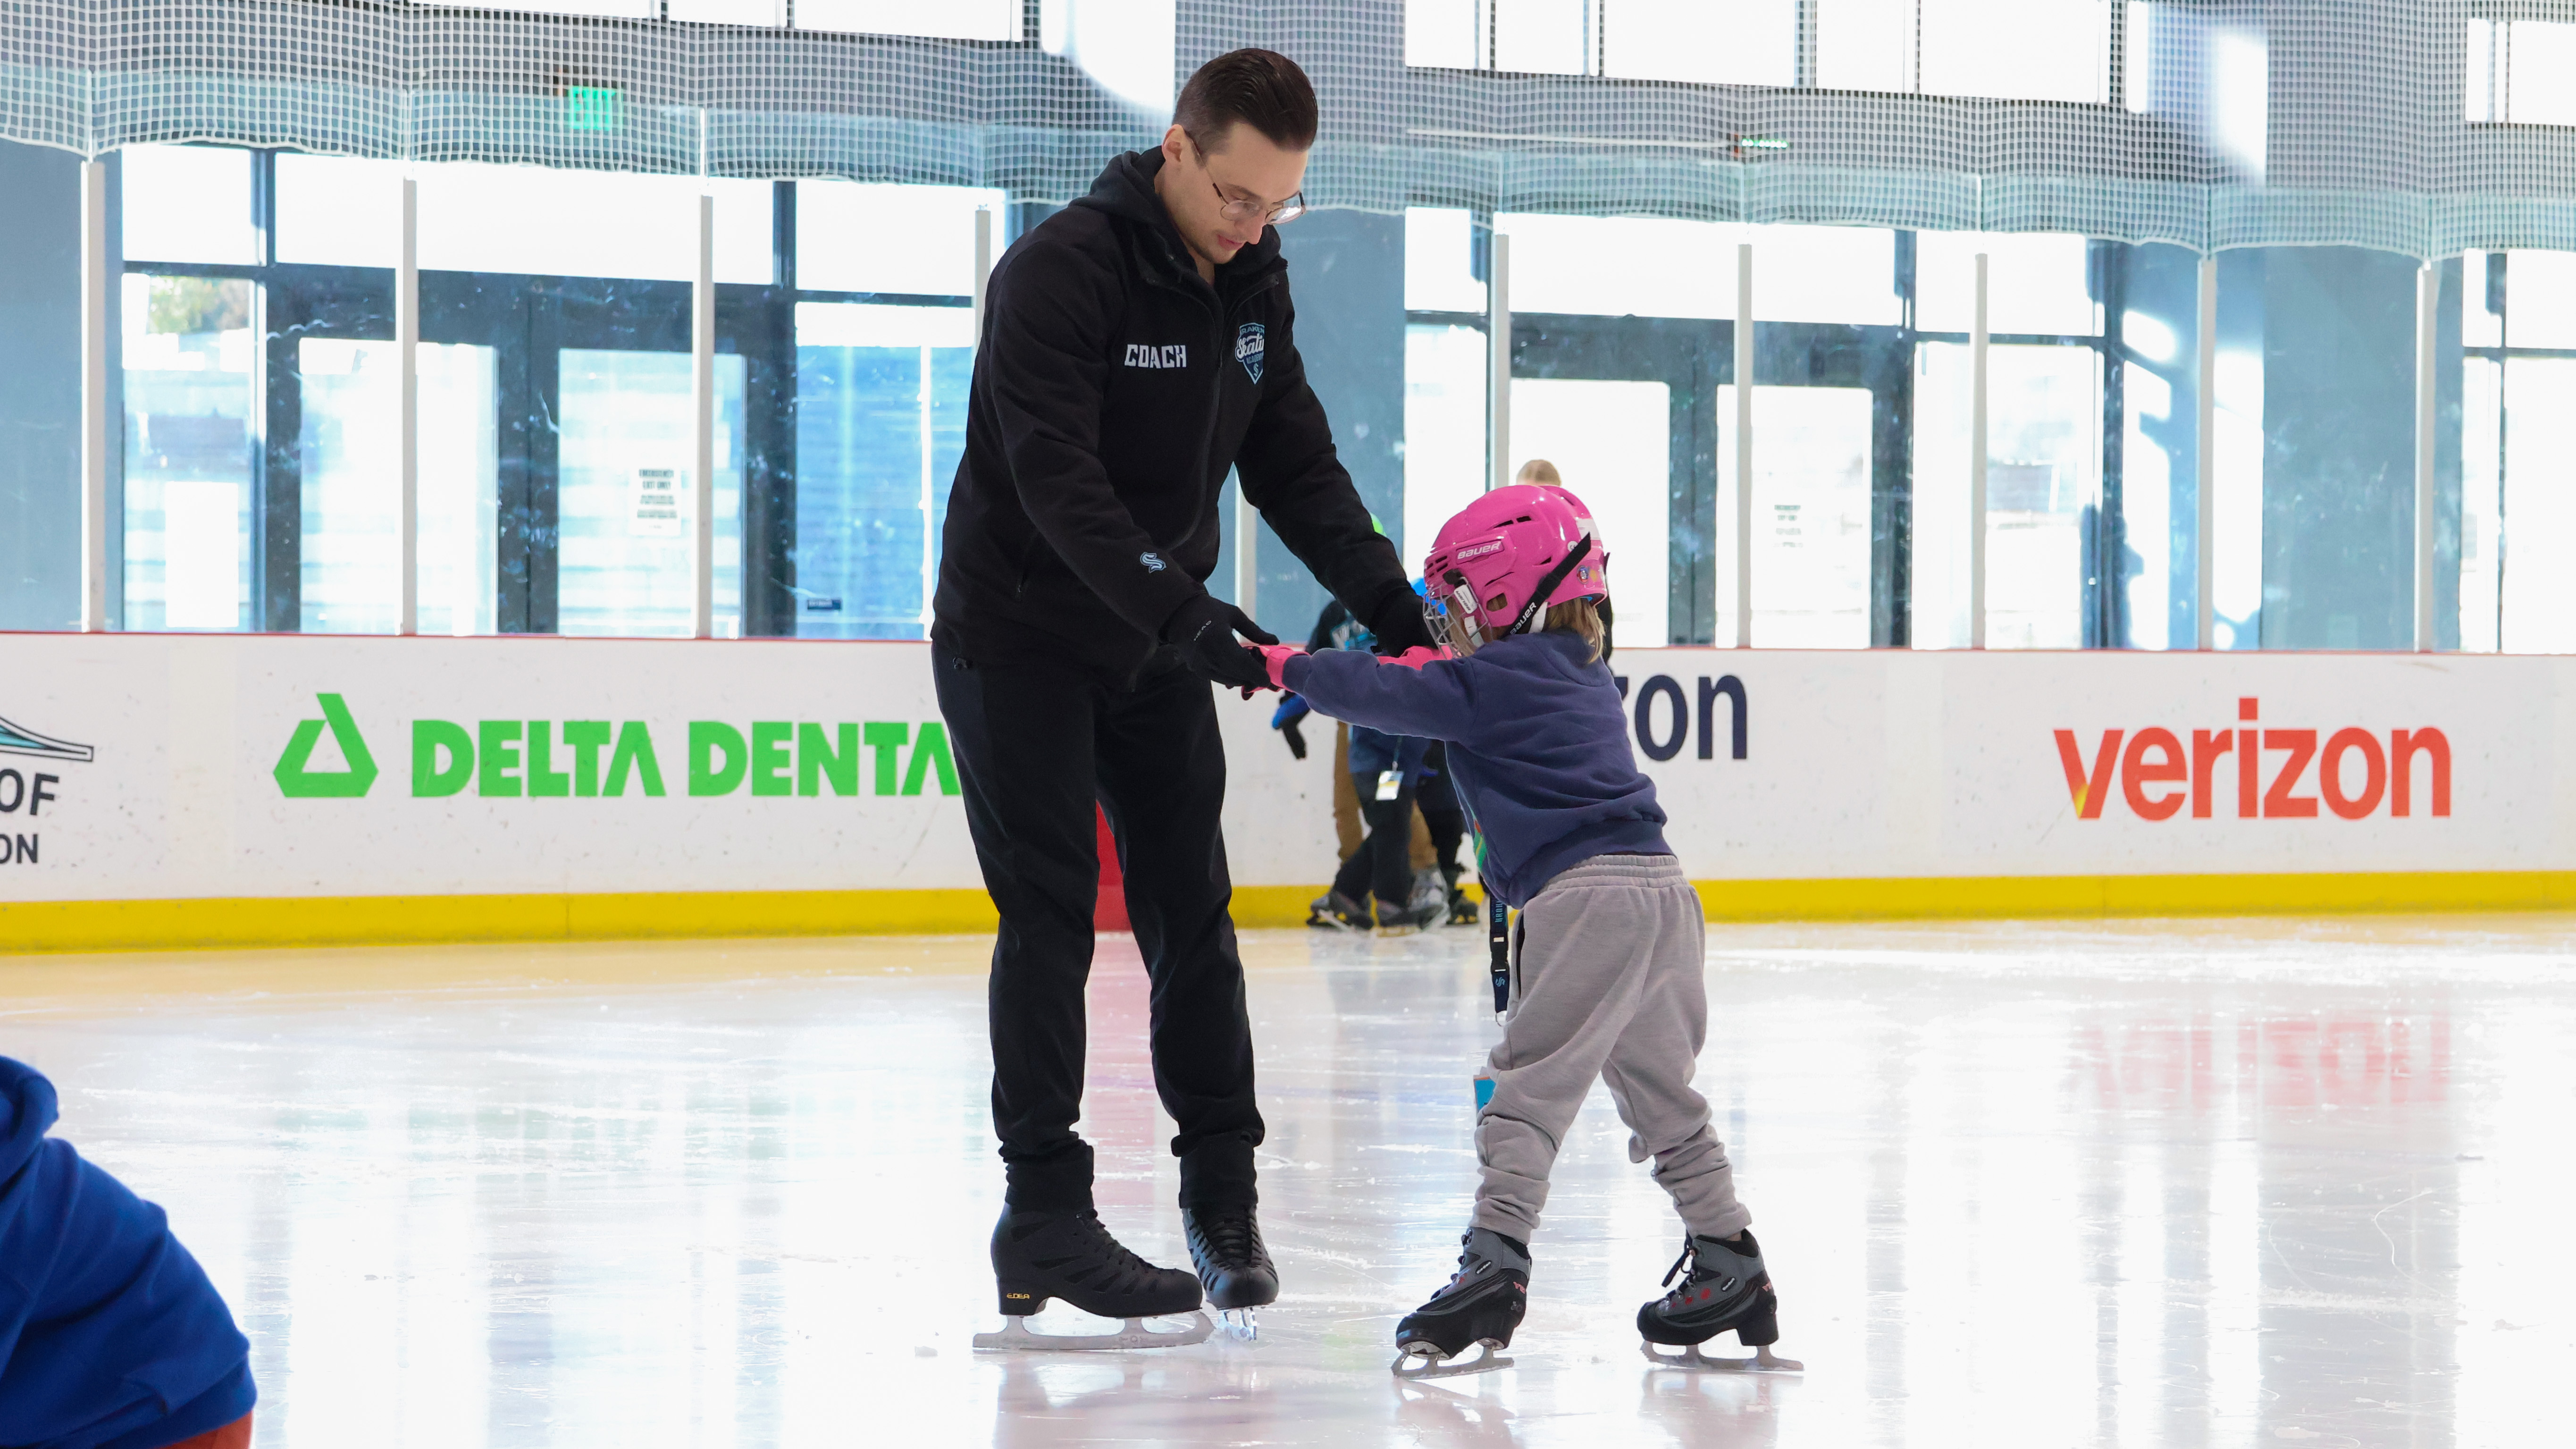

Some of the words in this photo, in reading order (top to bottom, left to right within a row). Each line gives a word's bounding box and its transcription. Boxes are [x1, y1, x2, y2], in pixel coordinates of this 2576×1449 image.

[1124, 344, 1187, 369] COACH
[1457, 541, 1502, 559] BAUER
[1510, 602, 1537, 635] BAUER
[412, 720, 666, 797] DELTA
[688, 721, 961, 796] DENTA
[2053, 697, 2451, 821] verizon
[0, 768, 59, 816] OF
